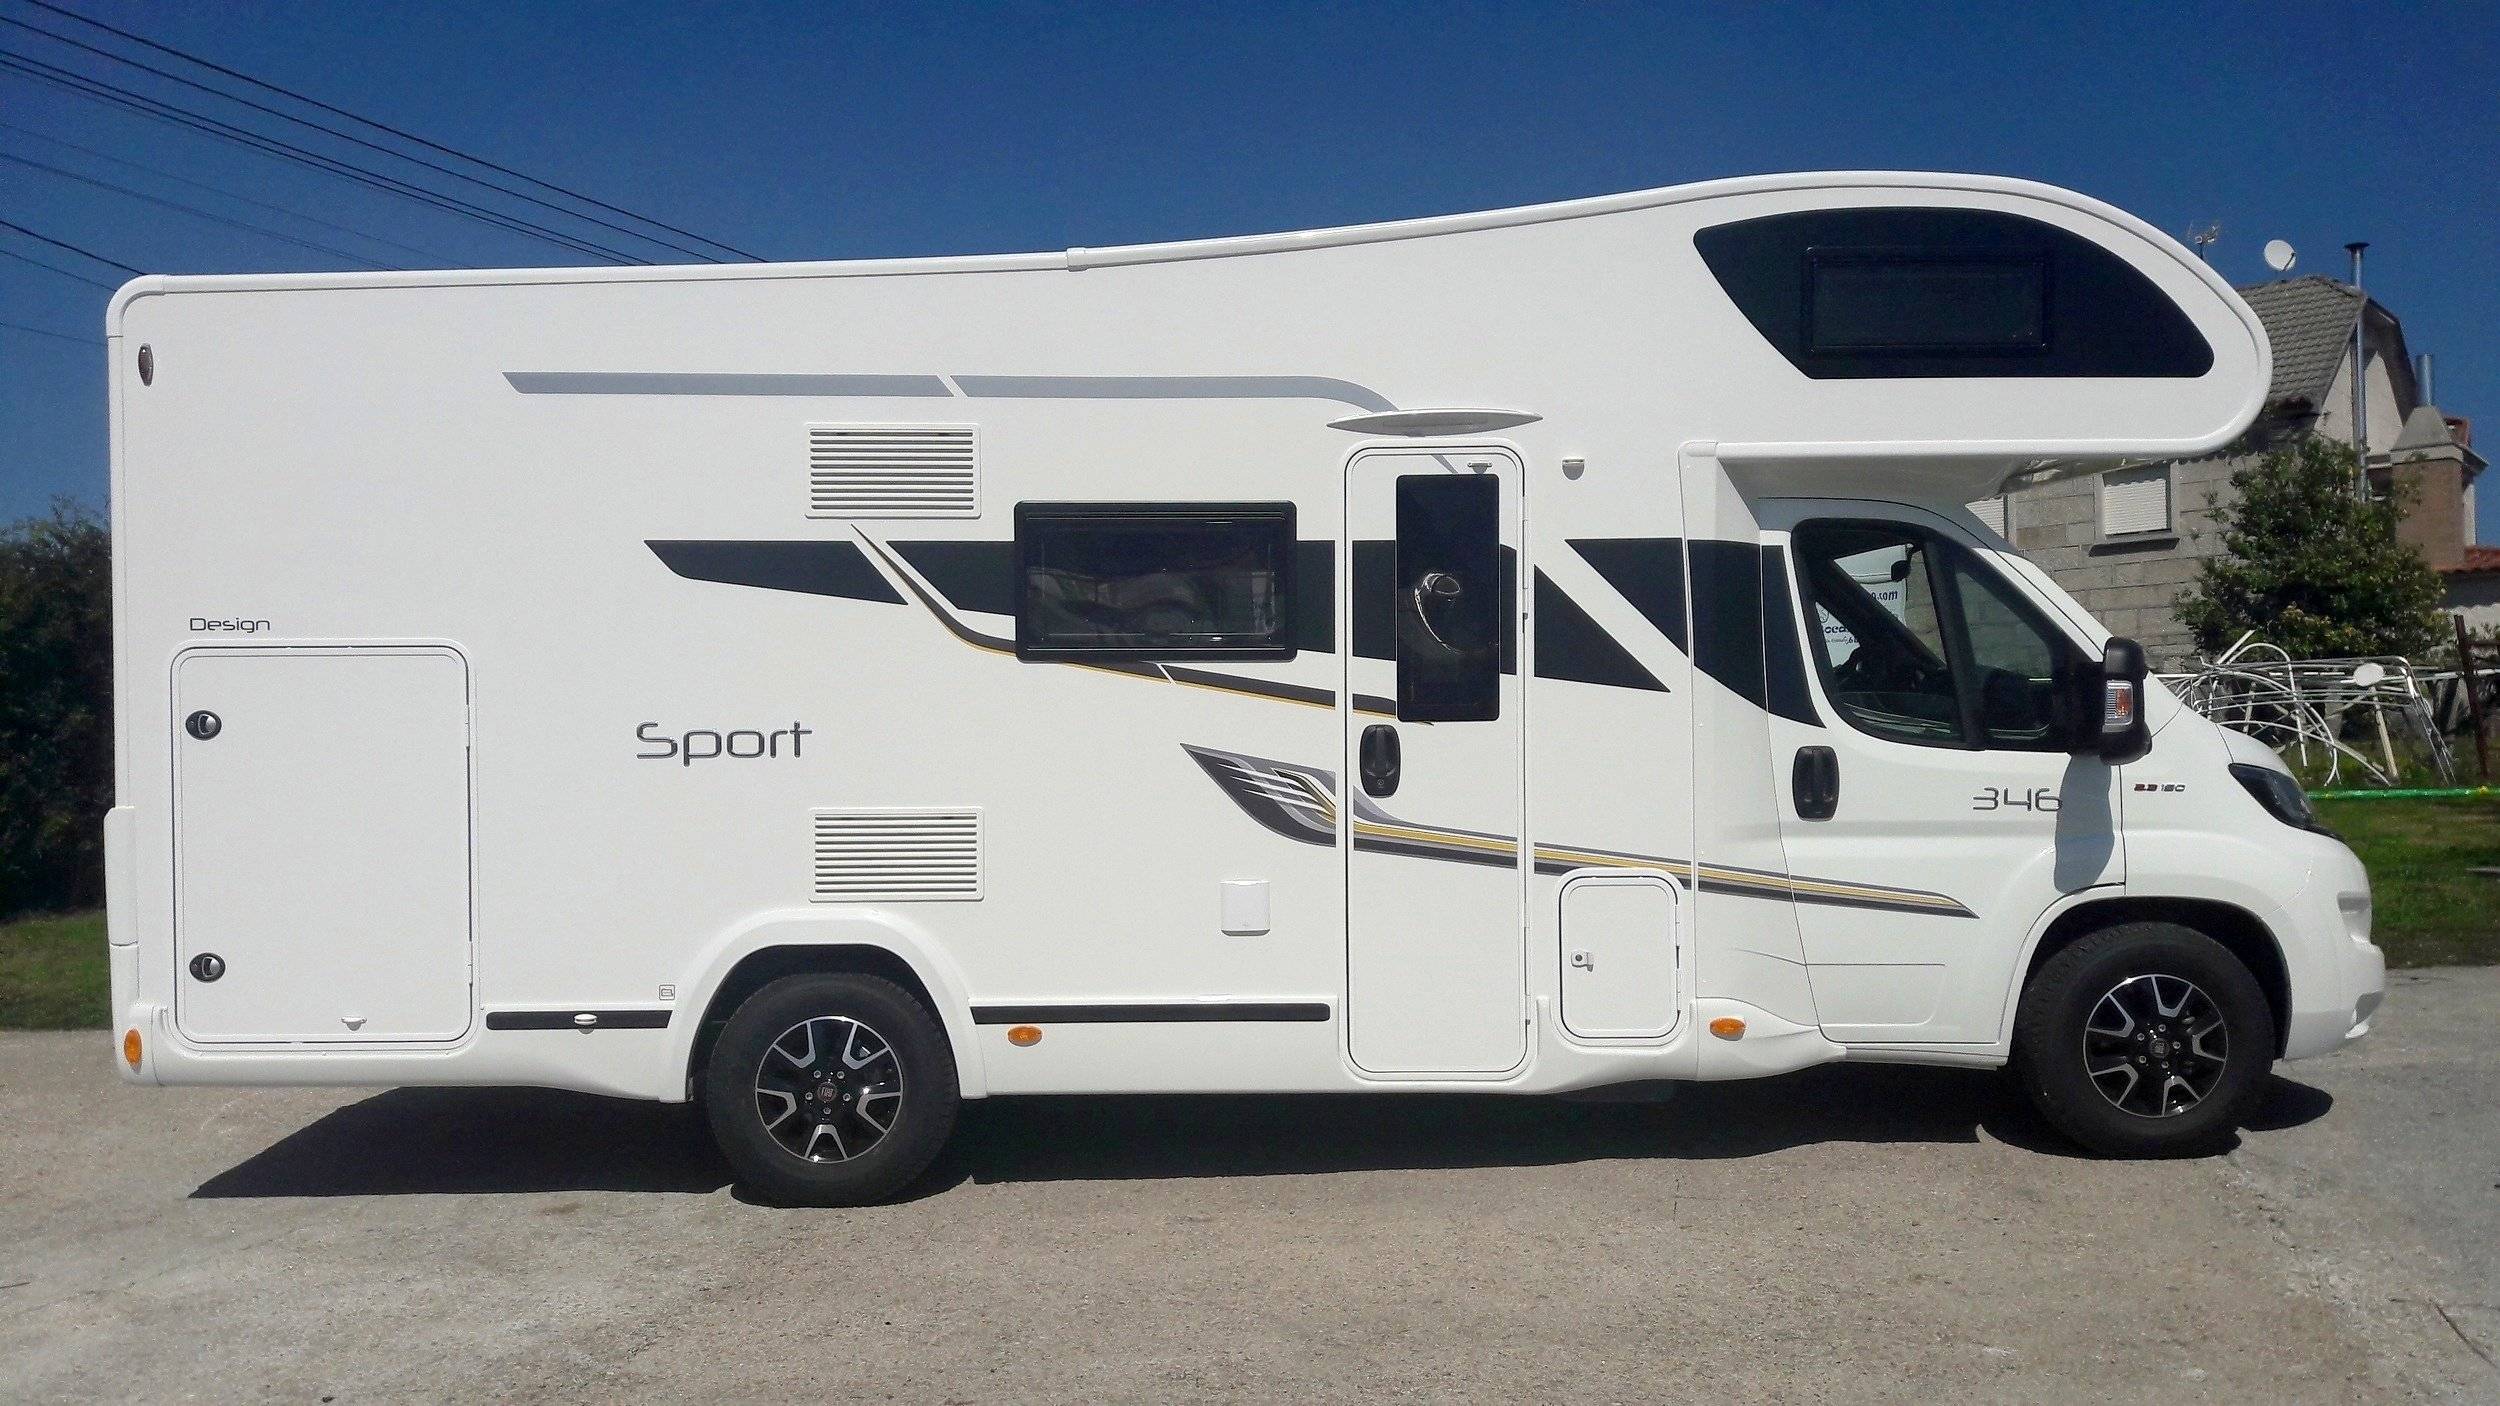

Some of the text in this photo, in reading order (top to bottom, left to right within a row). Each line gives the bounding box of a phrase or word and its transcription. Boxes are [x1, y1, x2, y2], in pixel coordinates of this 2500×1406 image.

[189, 617, 270, 634] Design
[636, 720, 813, 768] Sport
[1972, 786, 2063, 812] 346
